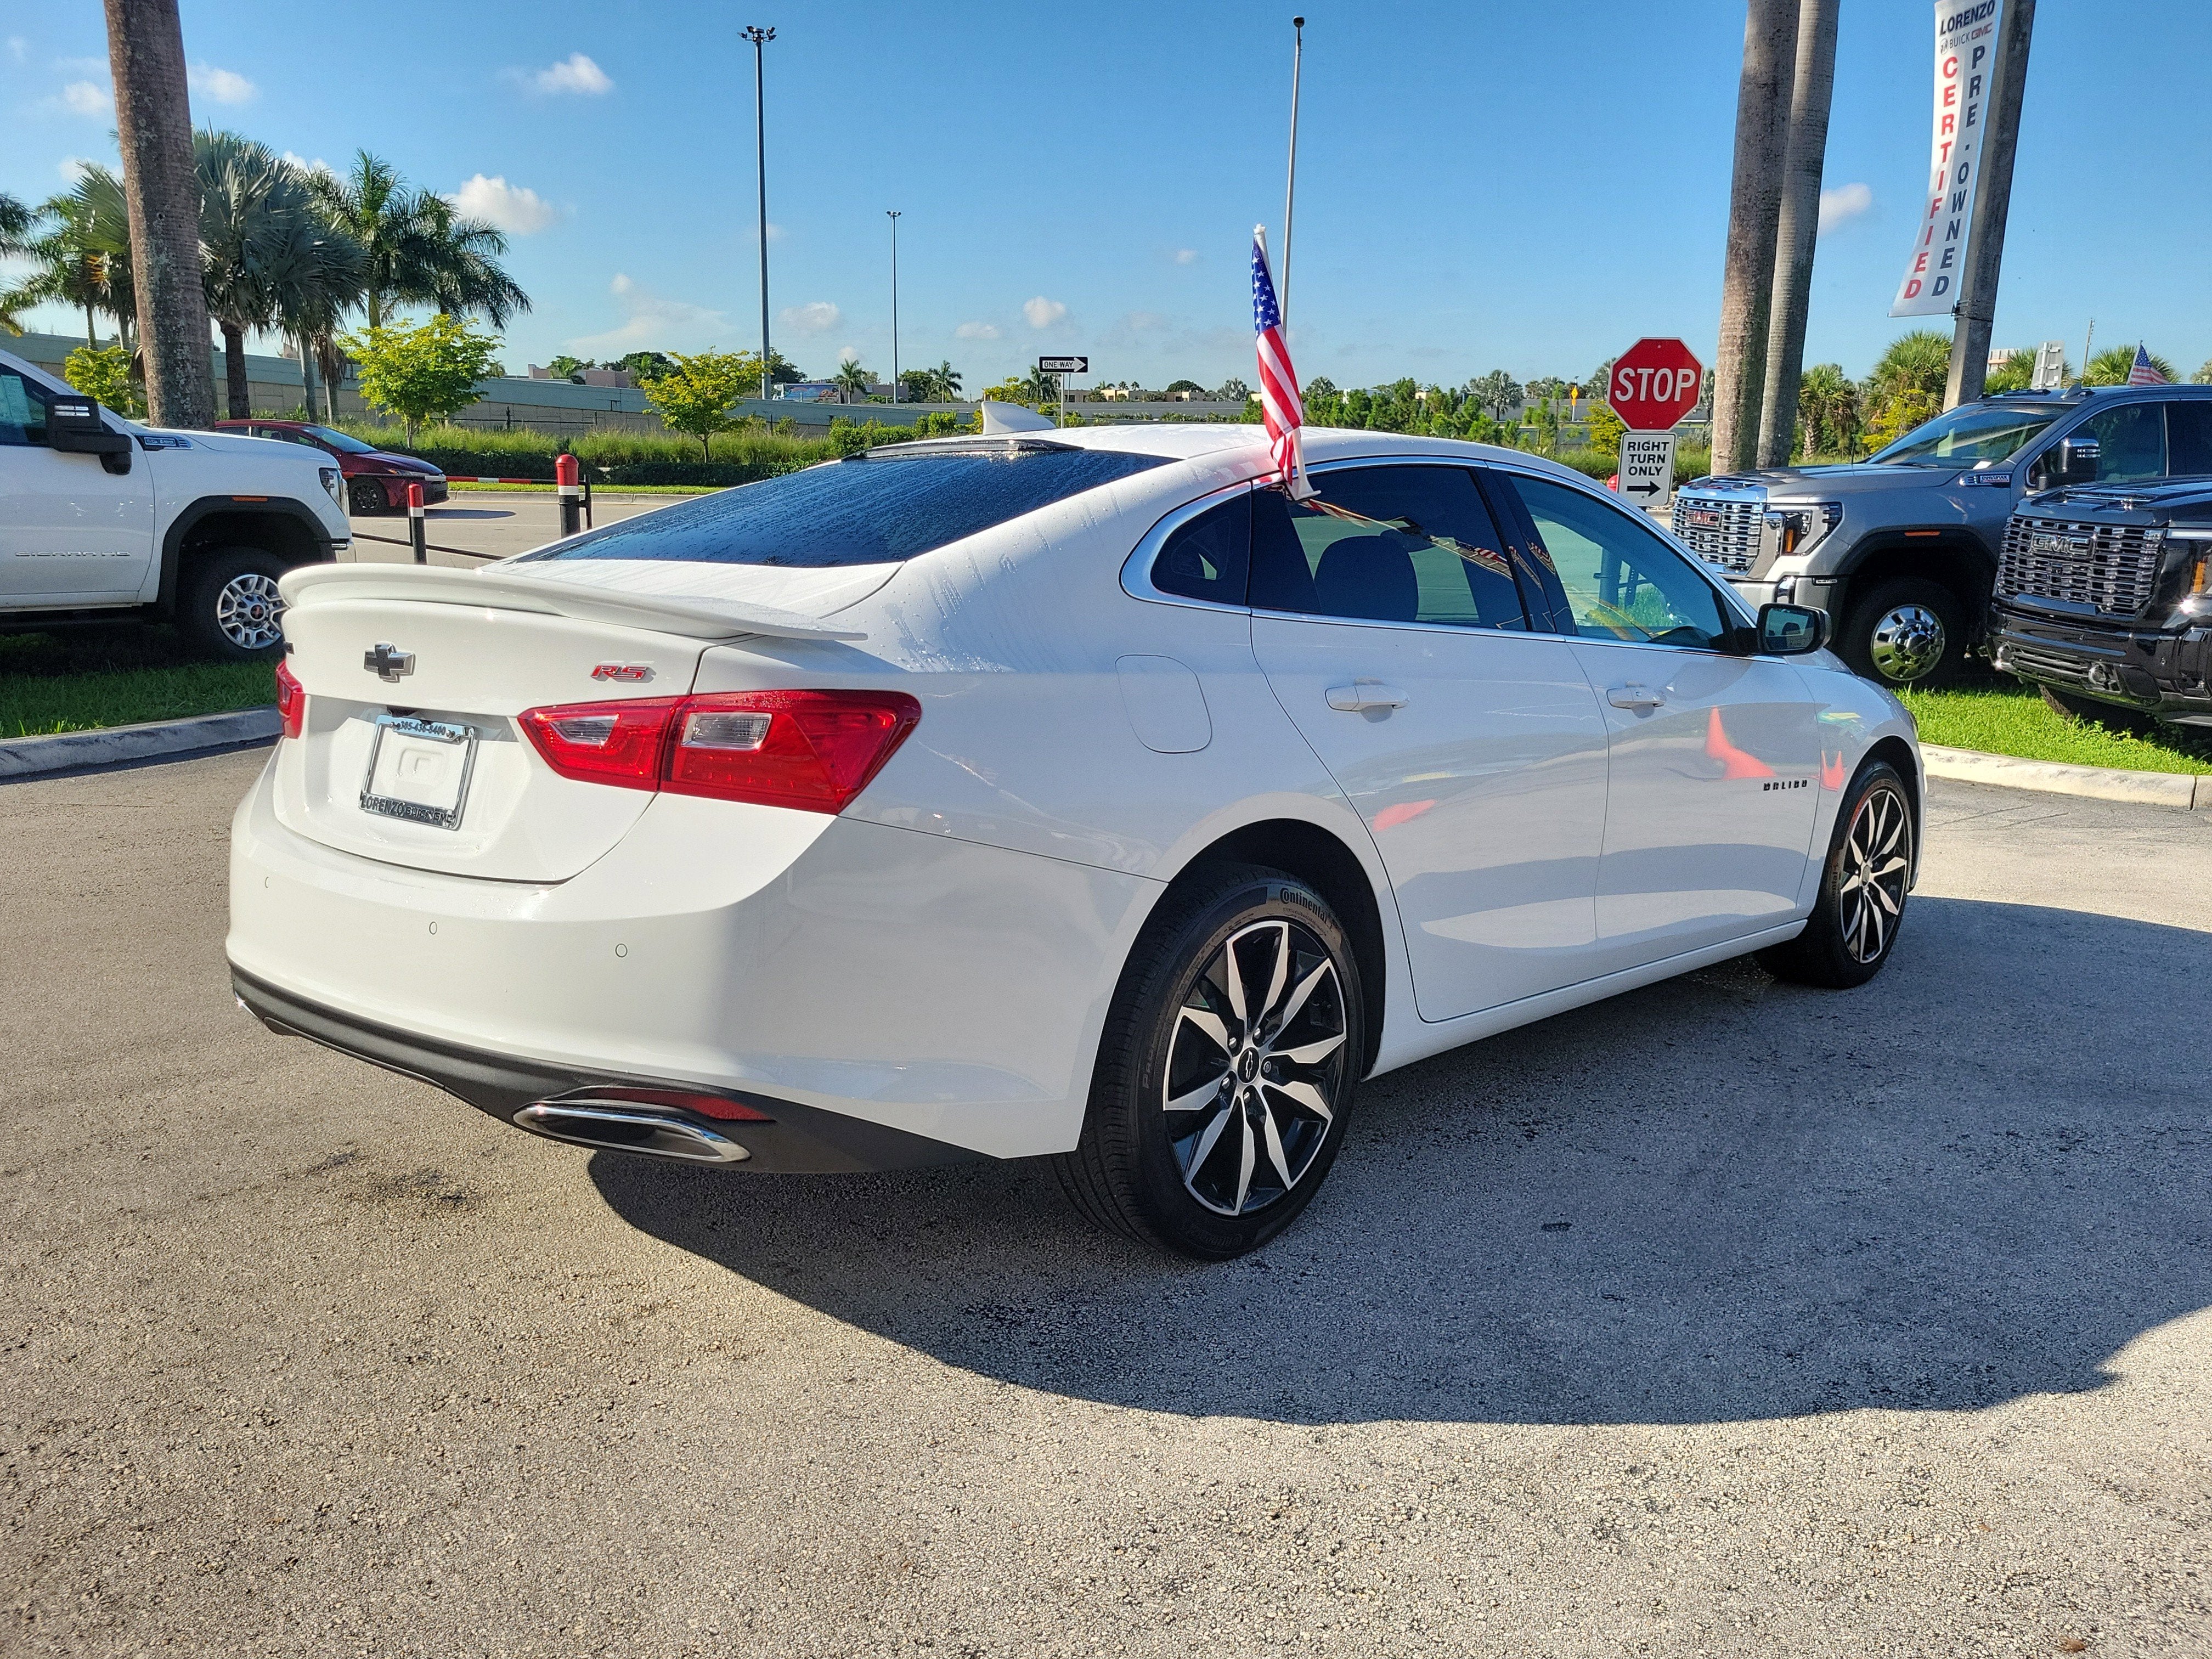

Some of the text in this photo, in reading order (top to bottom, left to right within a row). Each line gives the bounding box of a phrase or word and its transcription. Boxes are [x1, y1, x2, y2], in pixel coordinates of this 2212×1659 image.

[1939, 0, 1995, 36] LORENZO
[1949, 22, 1993, 49] BUICK GMC
[1903, 56, 1958, 299] CERTIFIED
[1615, 367, 1696, 402] STOP
[1627, 441, 1669, 452] RIGHT
[1629, 454, 1666, 464] TURN
[1628, 466, 1663, 476] ONLY
[1687, 509, 1718, 526] GMC
[2032, 533, 2089, 556] GMC
[590, 664, 646, 680] RS
[360, 794, 405, 817] LORENZO
[1280, 887, 1328, 924] Continental
